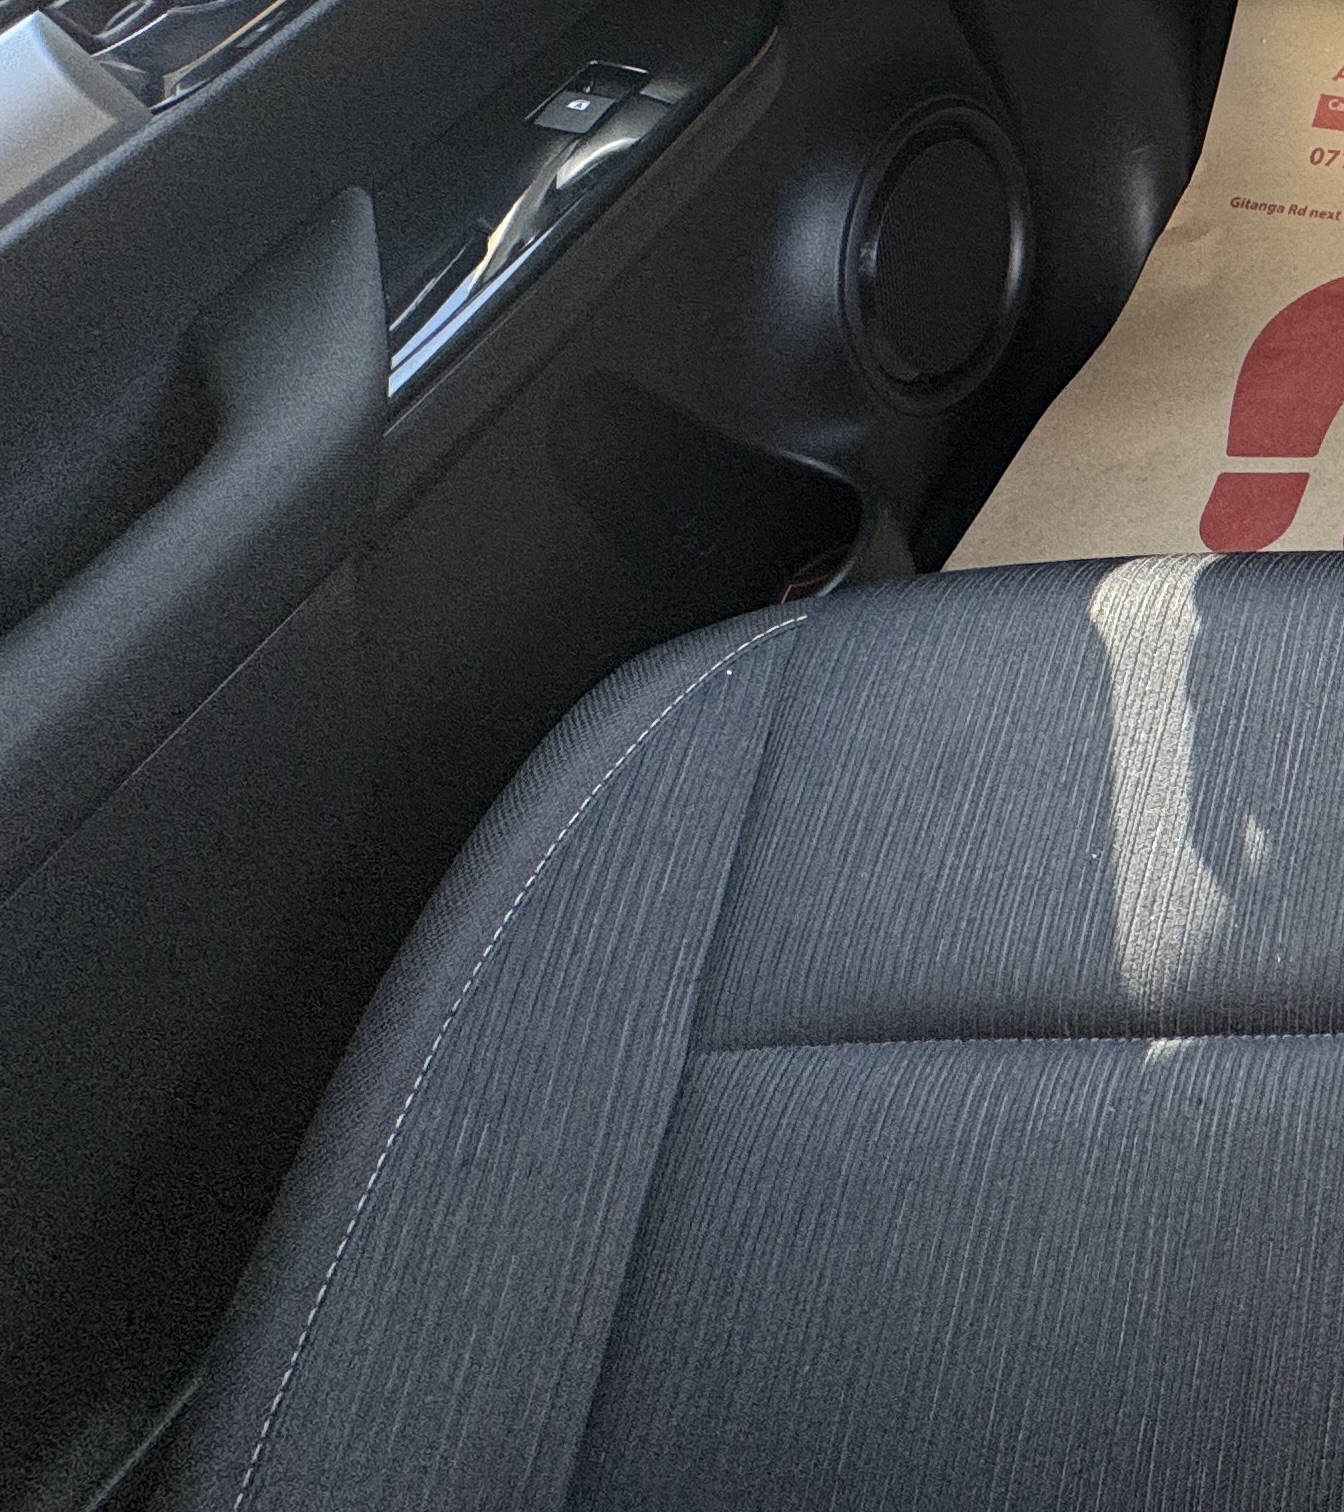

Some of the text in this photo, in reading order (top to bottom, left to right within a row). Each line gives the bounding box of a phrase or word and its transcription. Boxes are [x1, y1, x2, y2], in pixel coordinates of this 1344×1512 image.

[1230, 196, 1285, 216] Gitanga
[1288, 203, 1309, 218] Rd
[1309, 209, 1342, 221] next
